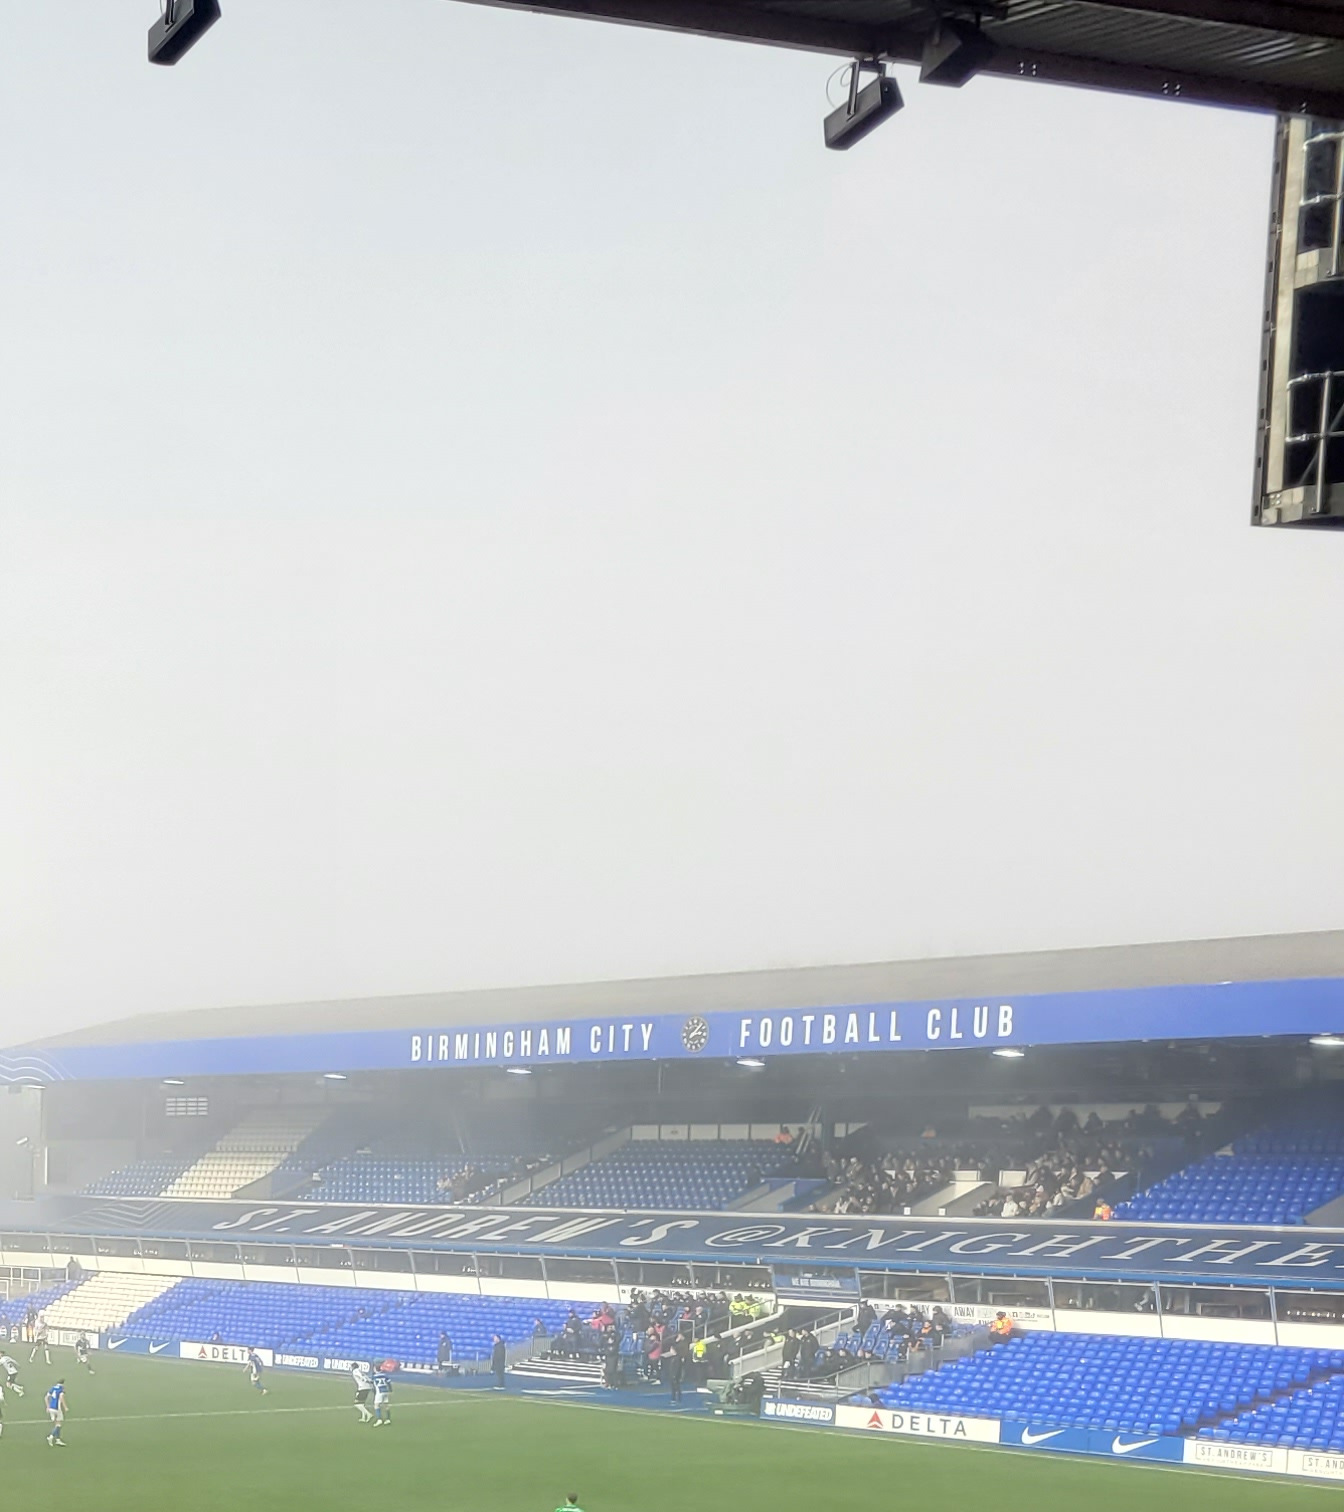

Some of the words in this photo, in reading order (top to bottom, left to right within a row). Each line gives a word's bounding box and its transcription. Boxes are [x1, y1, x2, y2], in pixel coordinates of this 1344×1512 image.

[411, 1027, 571, 1062] BIRMINGHAM
[590, 1023, 654, 1054] CITY
[740, 1011, 902, 1048] FOOTBALL
[927, 1005, 1013, 1040] CLUB
[212, 1207, 321, 1233] ST.
[309, 1209, 701, 1248] ANDREW'S
[703, 1223, 1344, 1269] @KNIGHTHE
[777, 1403, 833, 1421] UNDEFEATED
[892, 1413, 967, 1436] DELTA
[1217, 1448, 1268, 1462] ANDREW'S
